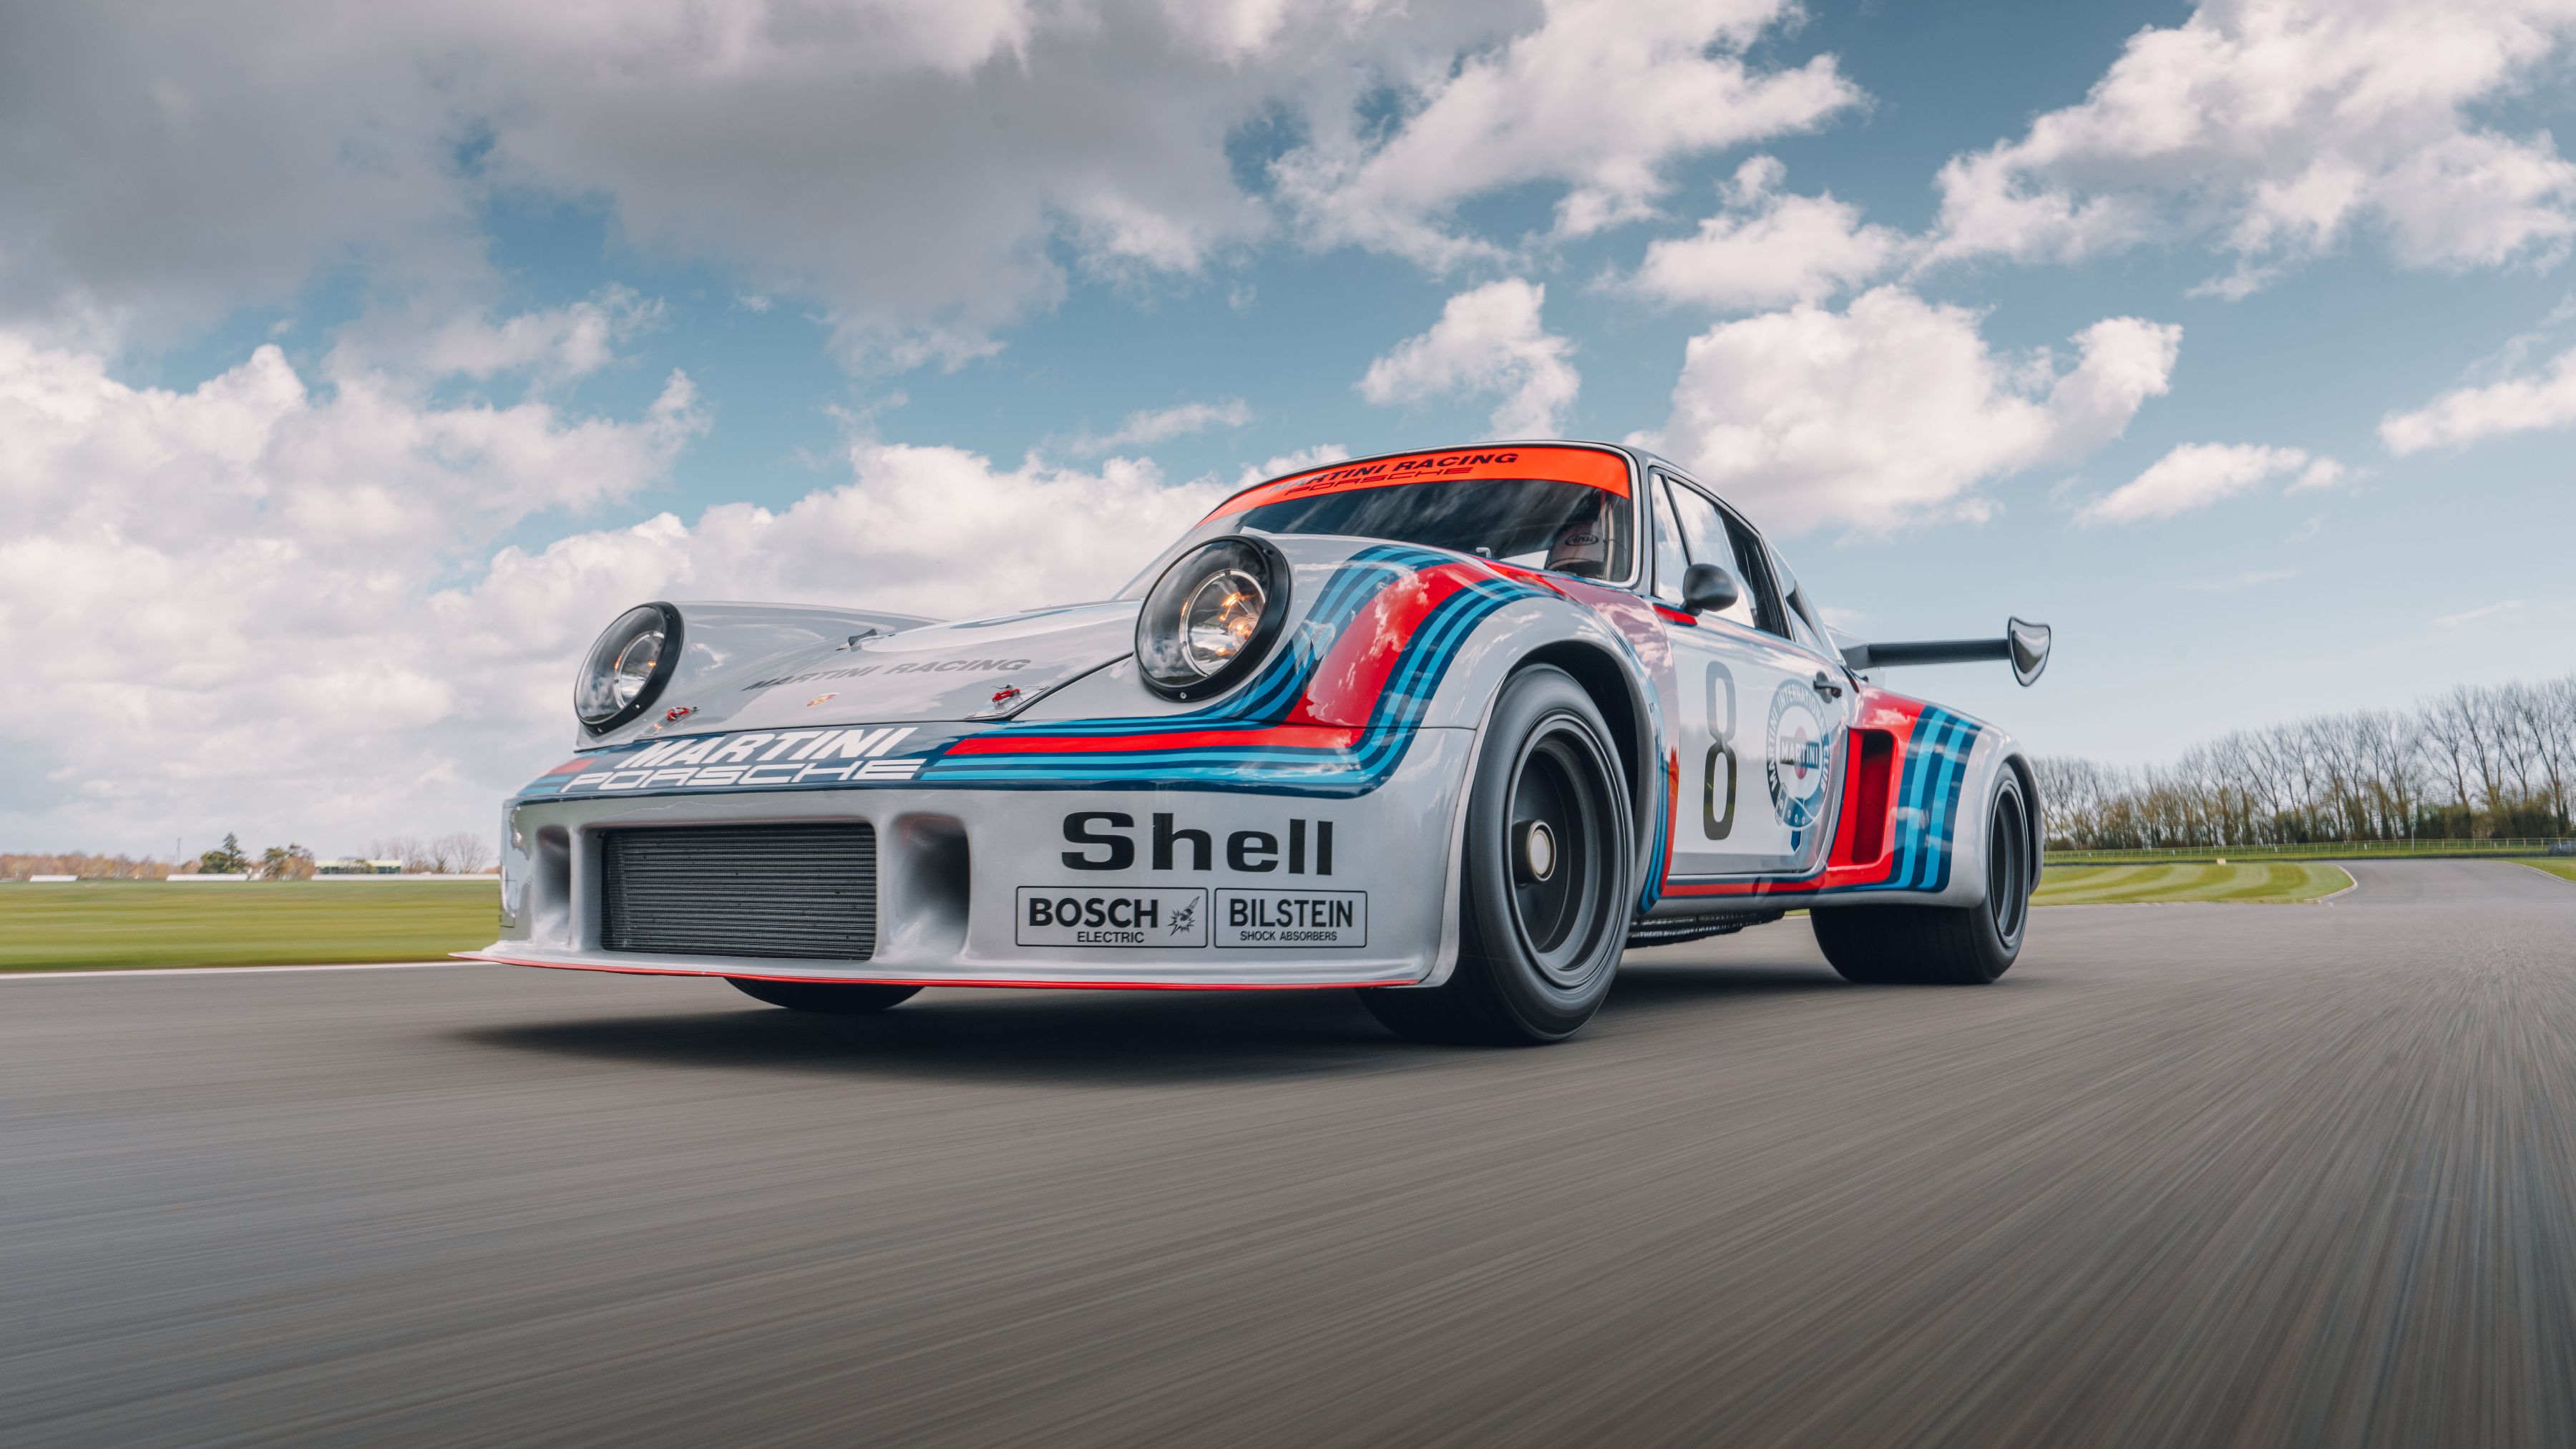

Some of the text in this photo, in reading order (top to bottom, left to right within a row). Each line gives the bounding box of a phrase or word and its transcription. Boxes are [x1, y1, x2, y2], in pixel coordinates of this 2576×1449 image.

[1267, 453, 1518, 493] MARTINI RACING
[1284, 467, 1473, 497] PORSCHE
[741, 659, 1031, 692] MARTINI RACING
[614, 727, 919, 769] MARTINI
[1704, 660, 1737, 840] 8
[1767, 706, 1778, 791] MARTINI
[1820, 745, 1830, 791] CLUB
[1780, 740, 1819, 766] MARTINI
[560, 758, 927, 793] PORSCHE
[1061, 811, 1334, 876] Shell
[1029, 897, 1158, 928] BOSCH
[1229, 899, 1353, 928] BILSTEIN
[1077, 931, 1145, 943] ELECTRIC
[1240, 931, 1337, 941] SHOCK ABSORBERS
